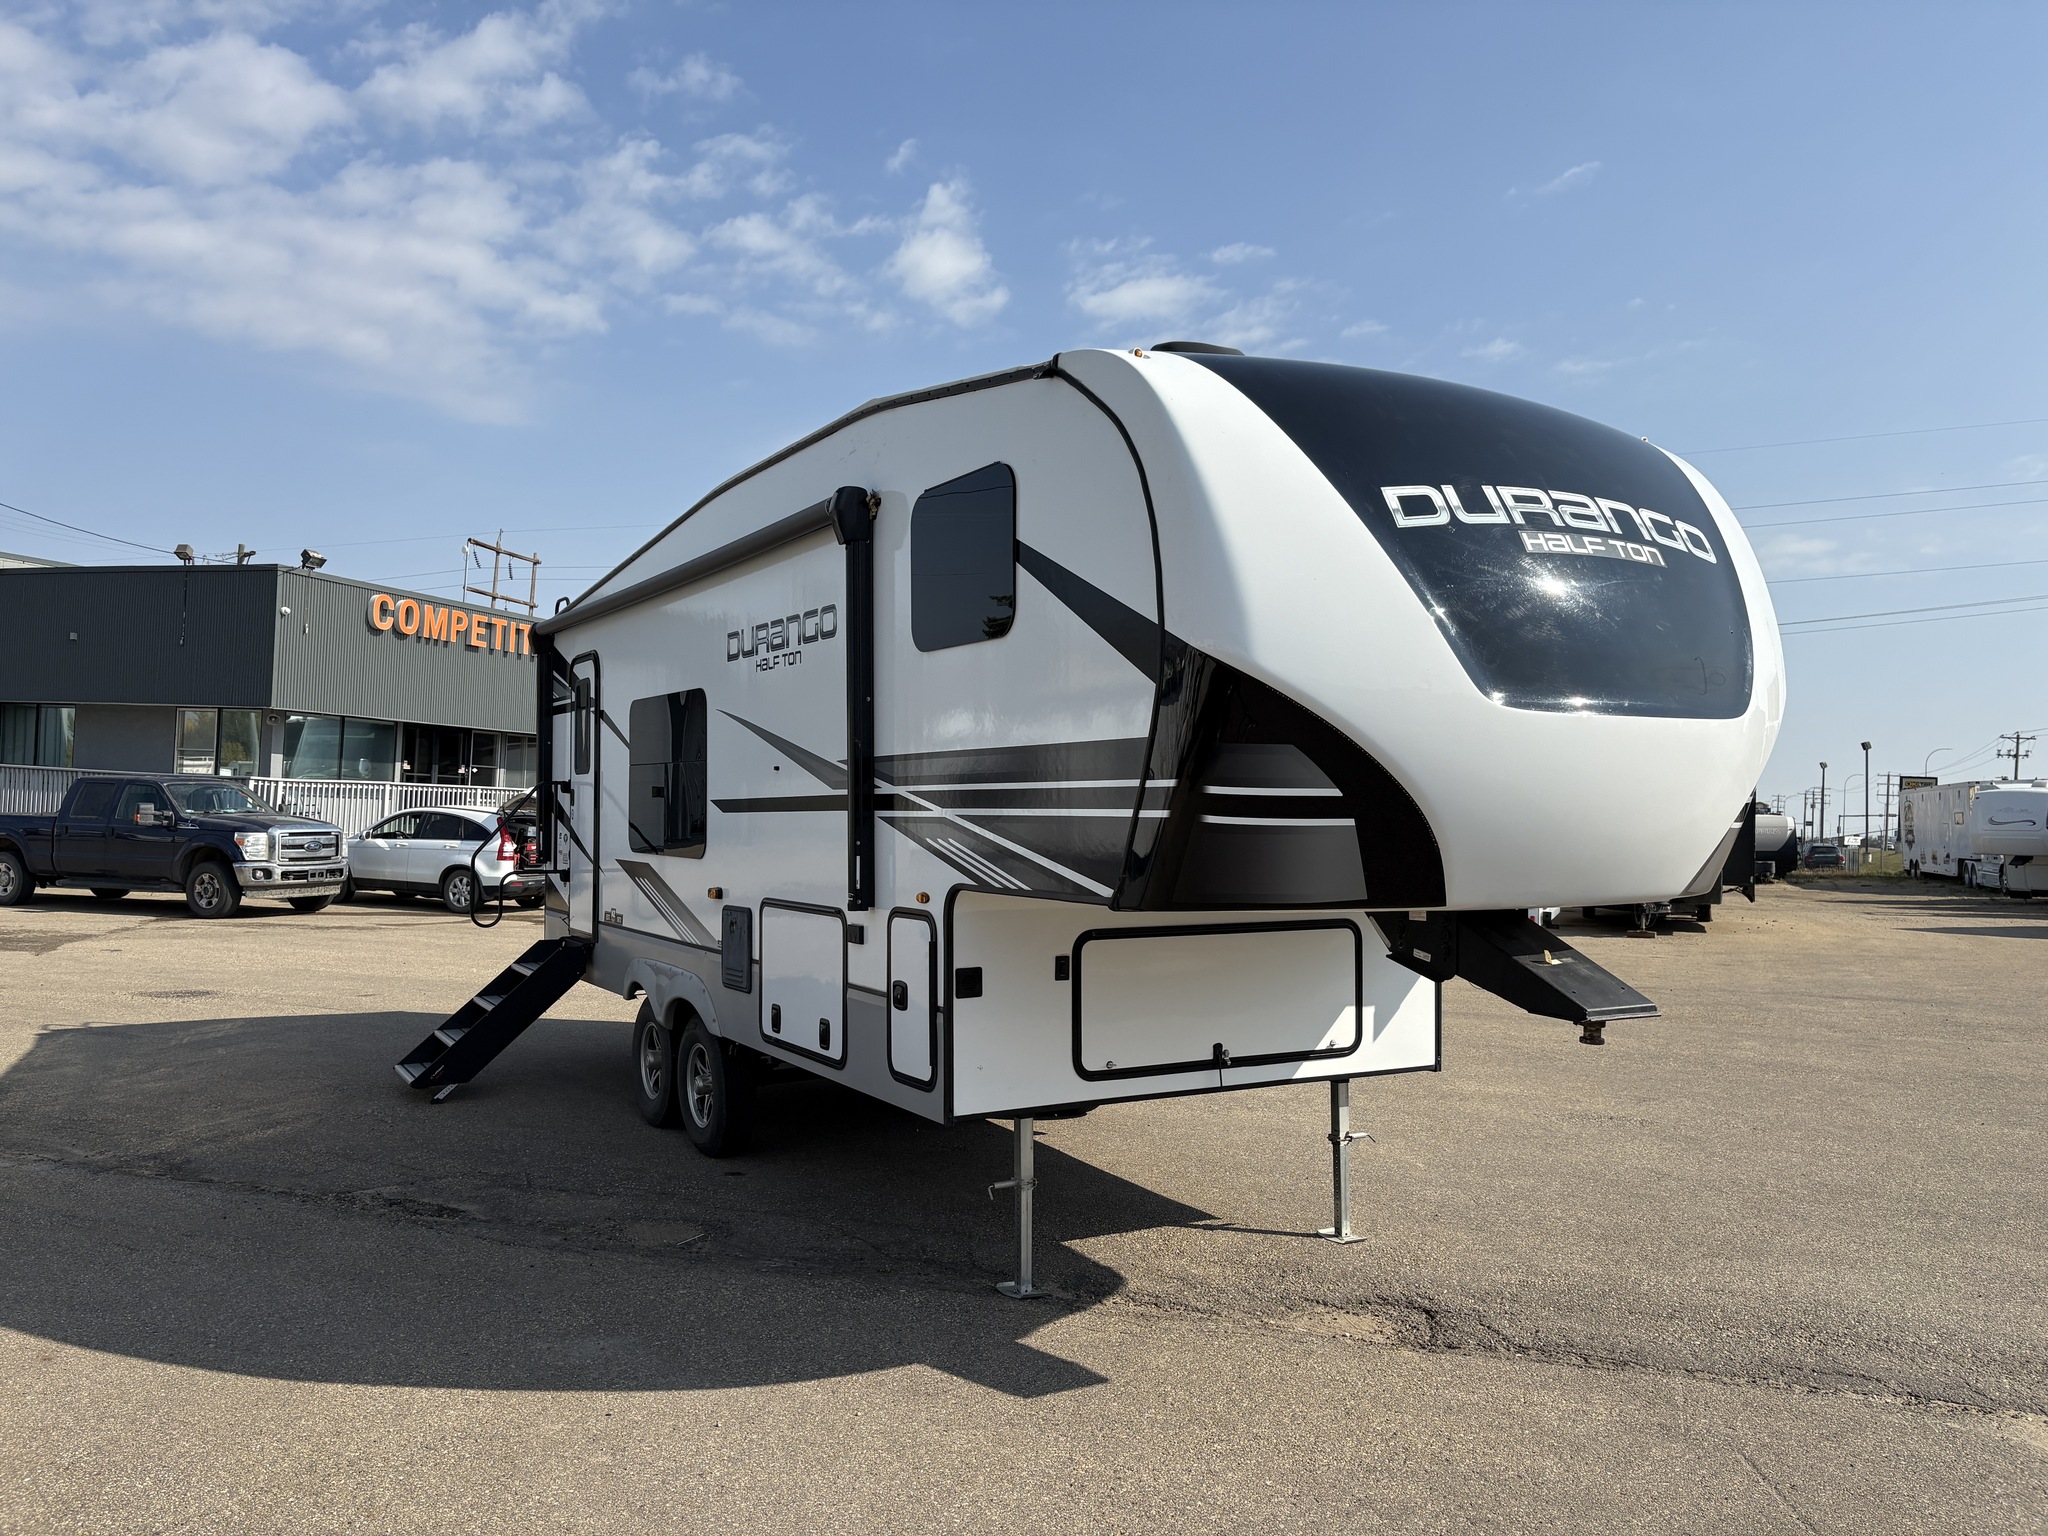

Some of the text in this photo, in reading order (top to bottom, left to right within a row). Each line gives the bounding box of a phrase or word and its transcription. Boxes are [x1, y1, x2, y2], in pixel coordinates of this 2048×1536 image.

[1380, 484, 1717, 564] DURANGO
[1521, 531, 1666, 567] HALF TON
[726, 603, 838, 663] DURANGO
[755, 650, 802, 673] HALF TON
